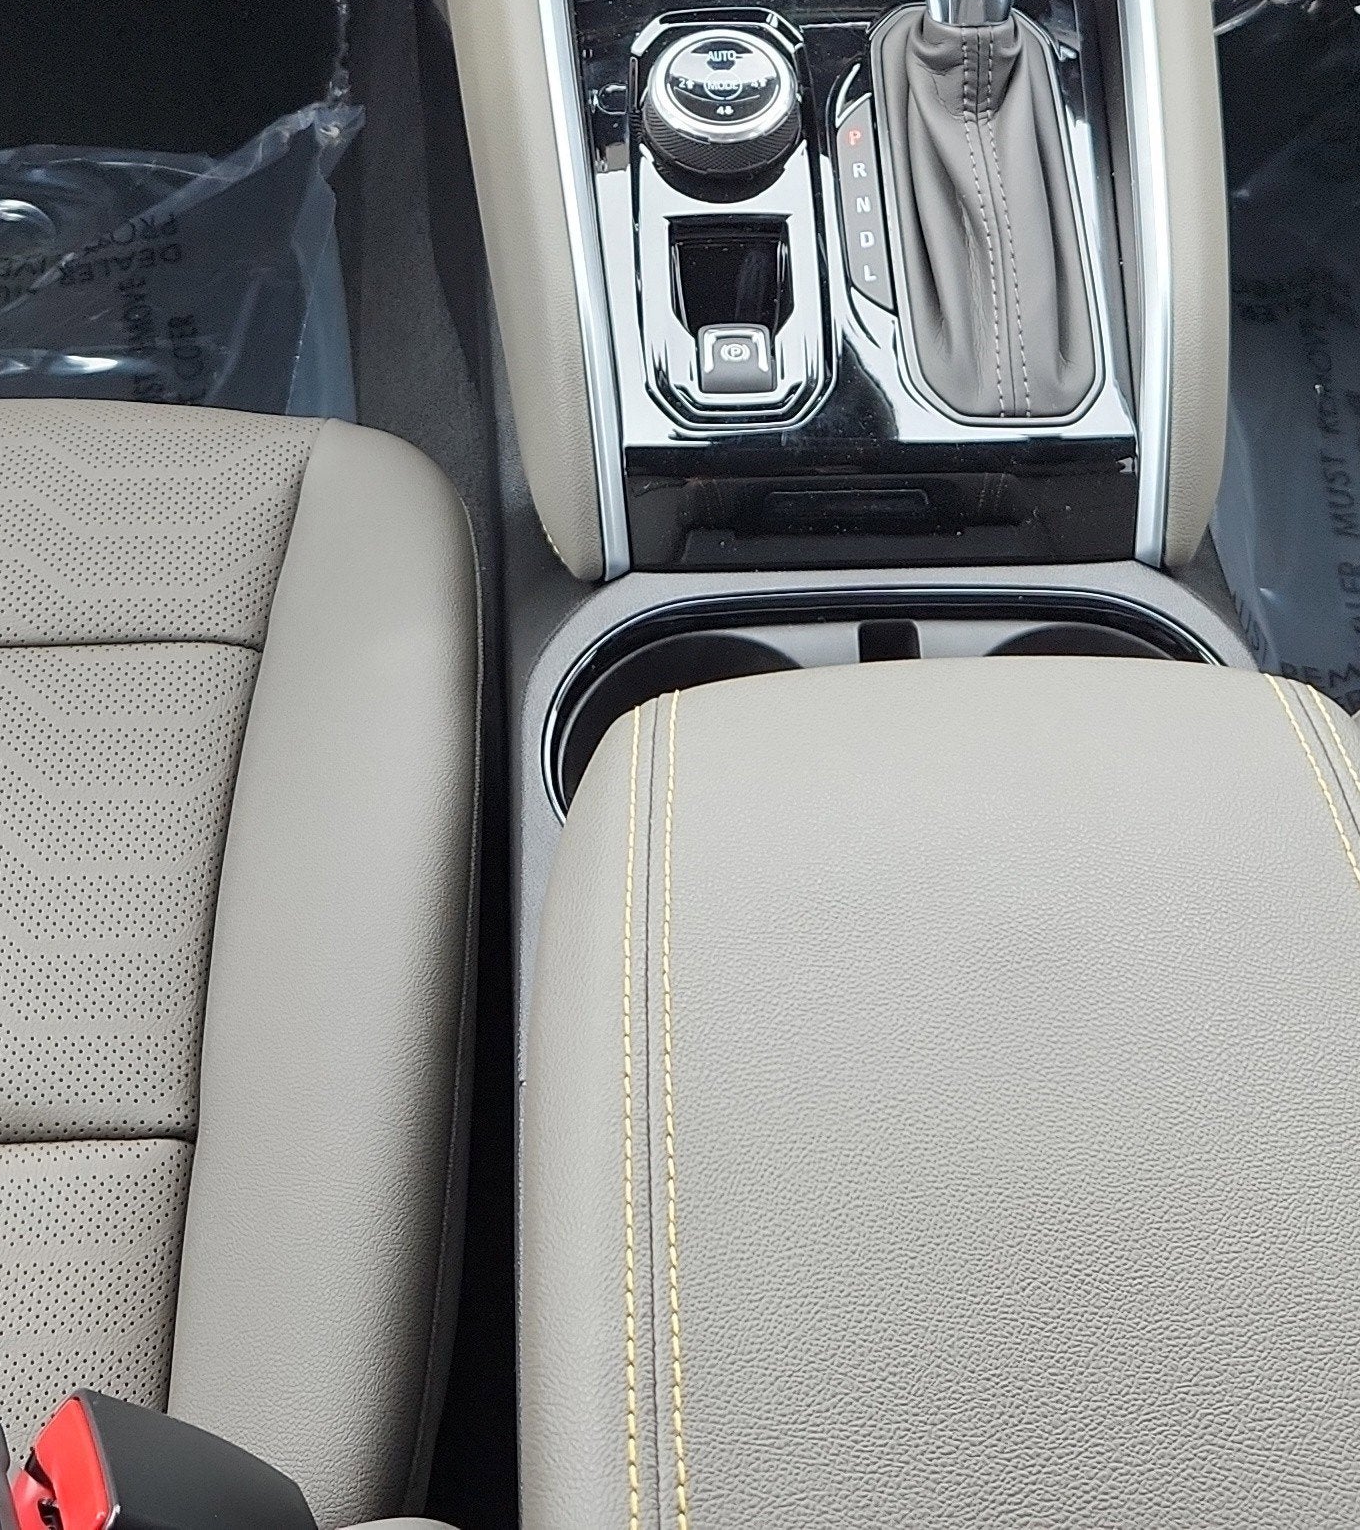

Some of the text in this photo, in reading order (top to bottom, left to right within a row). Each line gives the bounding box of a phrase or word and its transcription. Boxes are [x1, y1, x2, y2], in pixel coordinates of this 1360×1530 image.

[707, 50, 736, 61] AUTO
[848, 130, 861, 146] P
[852, 162, 868, 178] R
[856, 196, 871, 213] N
[859, 231, 875, 249] D
[863, 264, 877, 282] L
[1318, 451, 1360, 539] MUST
